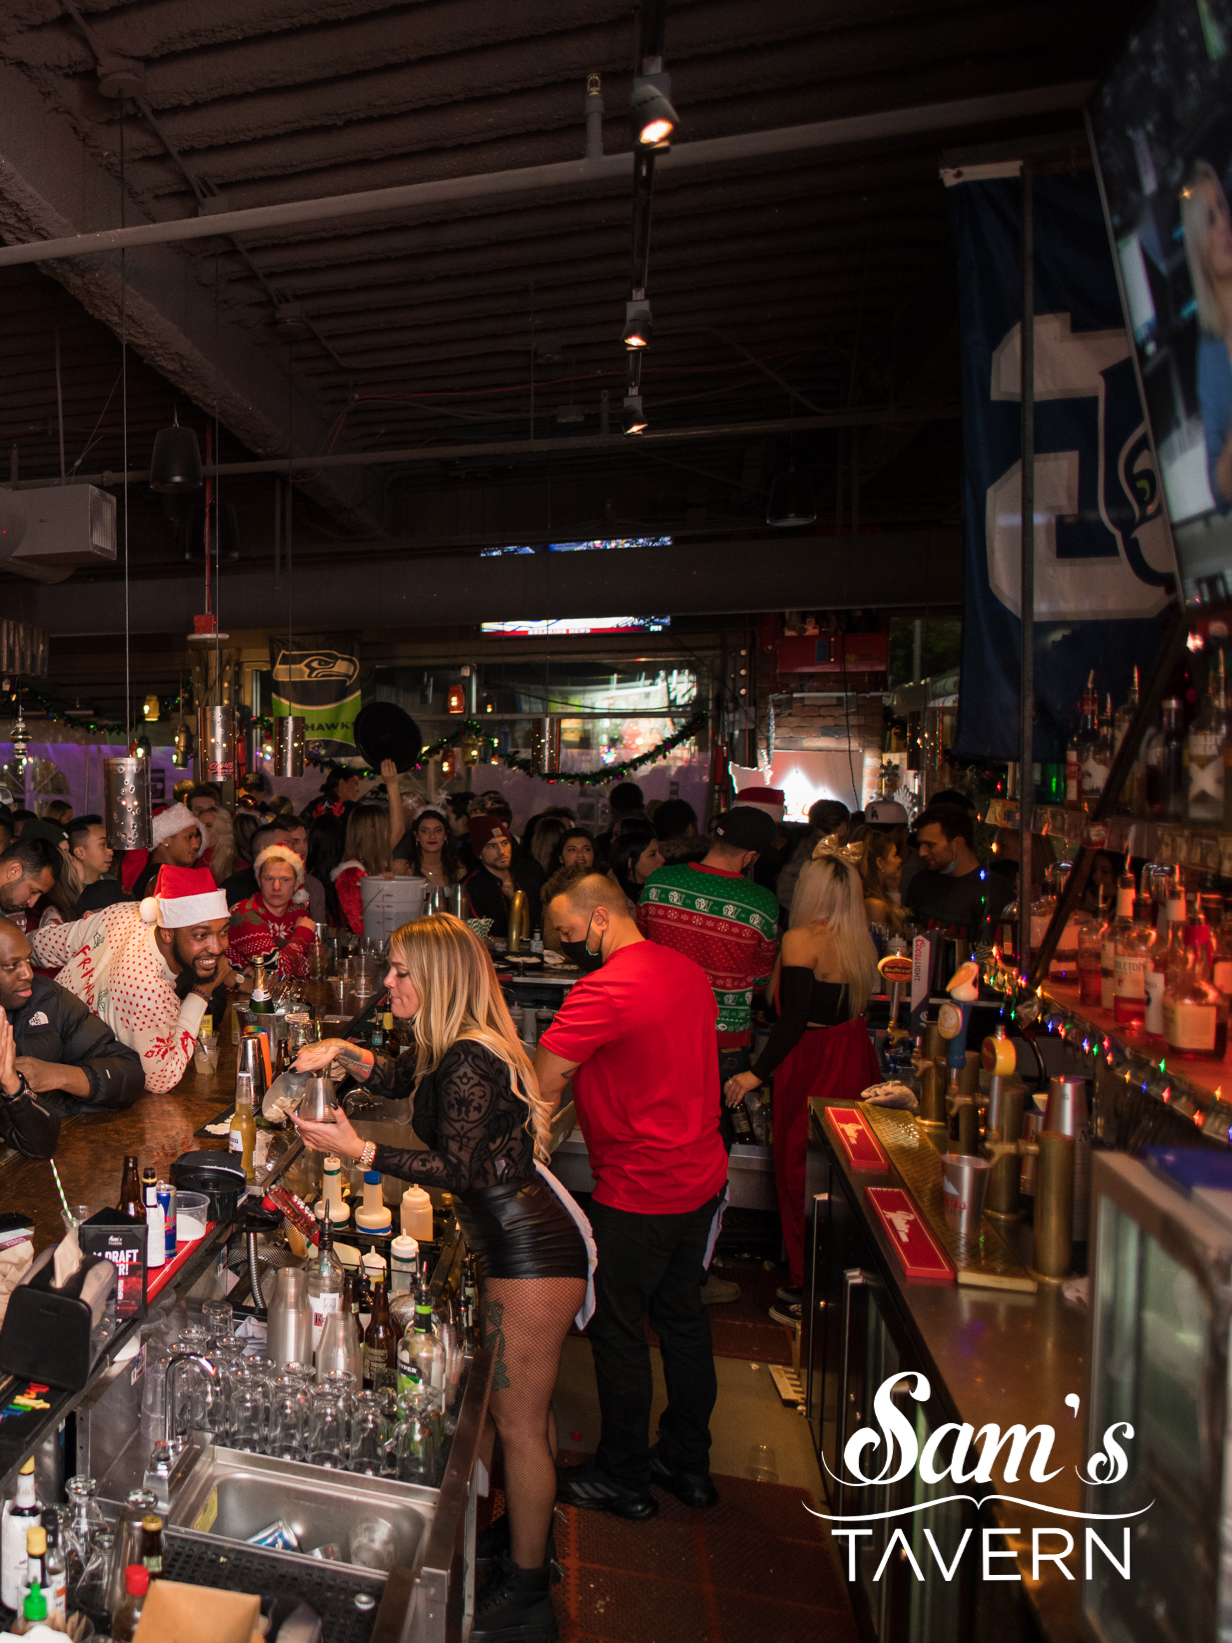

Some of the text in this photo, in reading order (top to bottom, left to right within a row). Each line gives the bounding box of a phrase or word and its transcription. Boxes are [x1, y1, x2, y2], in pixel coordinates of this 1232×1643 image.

[528, 627, 591, 636] BREAKING NEWS
[913, 938, 926, 982] Coors LIGHT
[104, 1248, 139, 1263] DRAFT
